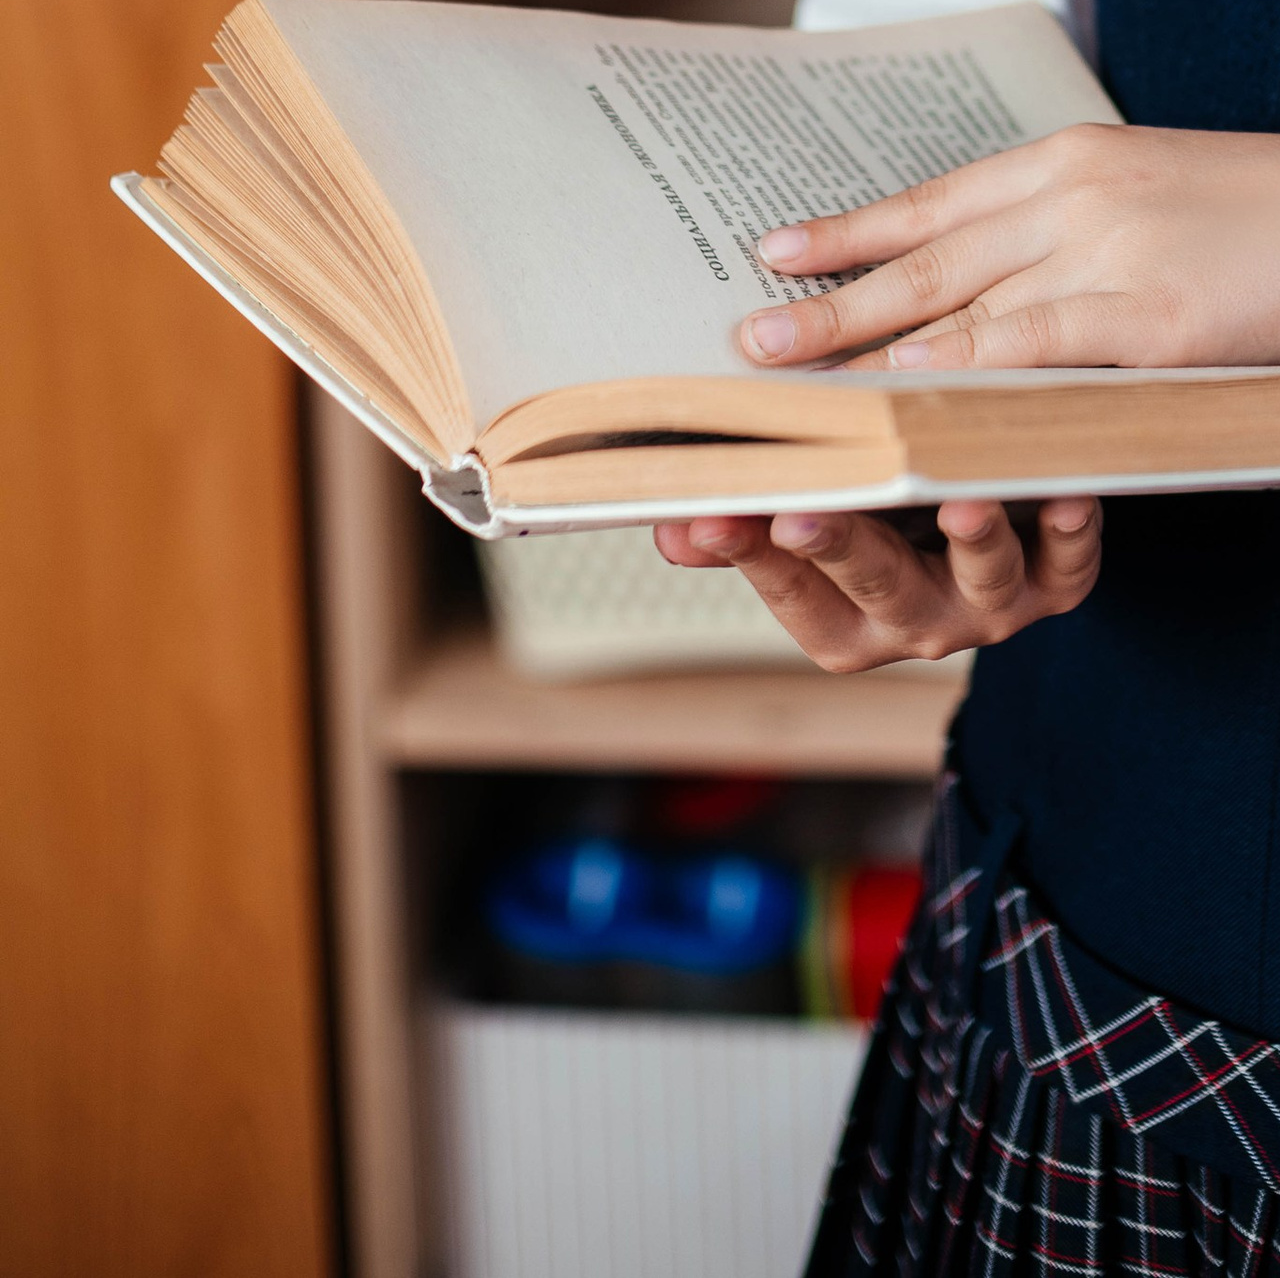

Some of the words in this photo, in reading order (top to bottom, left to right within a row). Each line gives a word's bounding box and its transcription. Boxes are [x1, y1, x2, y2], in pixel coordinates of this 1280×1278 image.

[583, 84, 658, 169] ЭКОНОМИКА
[671, 124, 722, 183] политиков.
[675, 154, 705, 184] слово
[716, 164, 774, 230] социальной
[718, 188, 740, 206] уст
[649, 173, 732, 281] СОЦИАЛЬНАЯ
[702, 191, 735, 226] время
[730, 233, 778, 297] последнее
